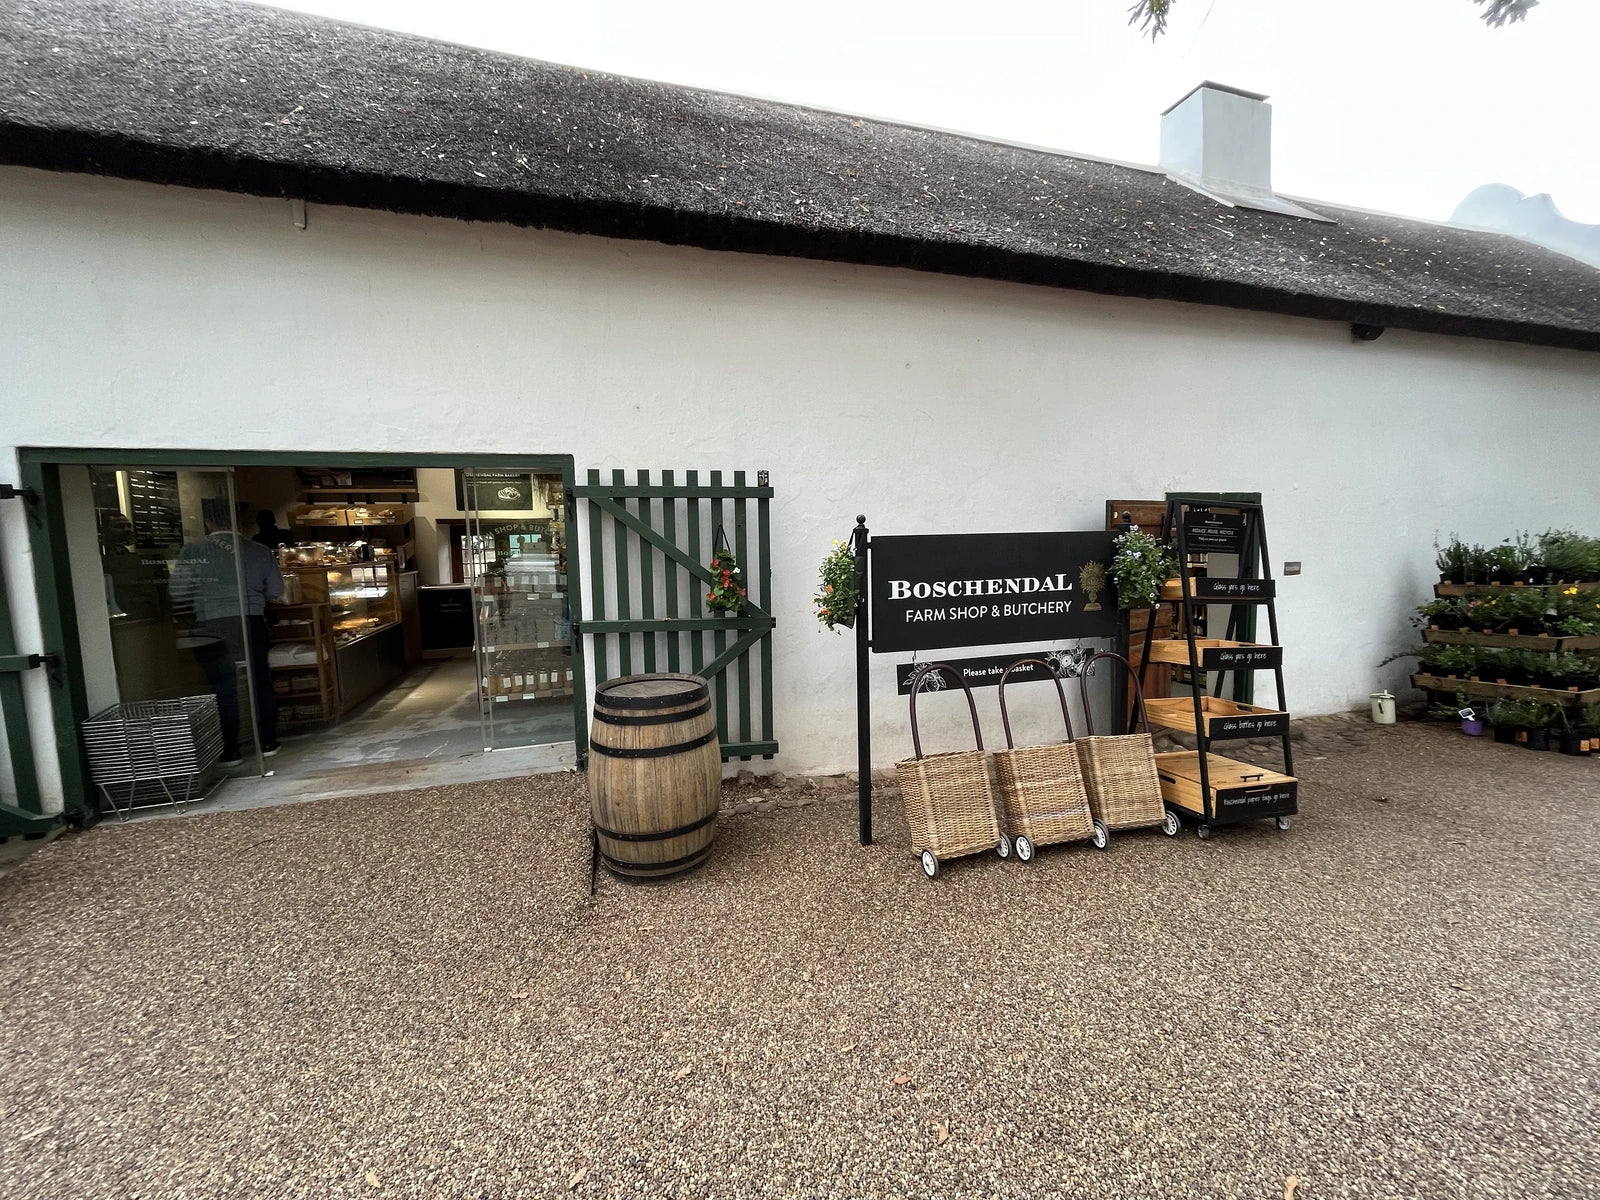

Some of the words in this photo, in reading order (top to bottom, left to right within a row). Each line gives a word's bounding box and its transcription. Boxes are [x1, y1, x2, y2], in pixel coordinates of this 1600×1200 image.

[495, 524, 518, 535] SHOP
[888, 573, 1073, 600] BOSCHENDAL
[1213, 581, 1227, 590] Glass
[1247, 583, 1260, 591] here
[905, 607, 946, 623] FARM
[949, 605, 988, 620] SHOP
[991, 605, 1001, 618] &
[1003, 600, 1073, 617] BUTCHERY
[1220, 651, 1234, 660] Glass
[1253, 651, 1267, 659] here
[963, 668, 987, 677] Please
[988, 665, 1004, 675] take
[1223, 720, 1238, 730] Glass
[1238, 720, 1255, 729] bottles
[1263, 719, 1277, 727] here
